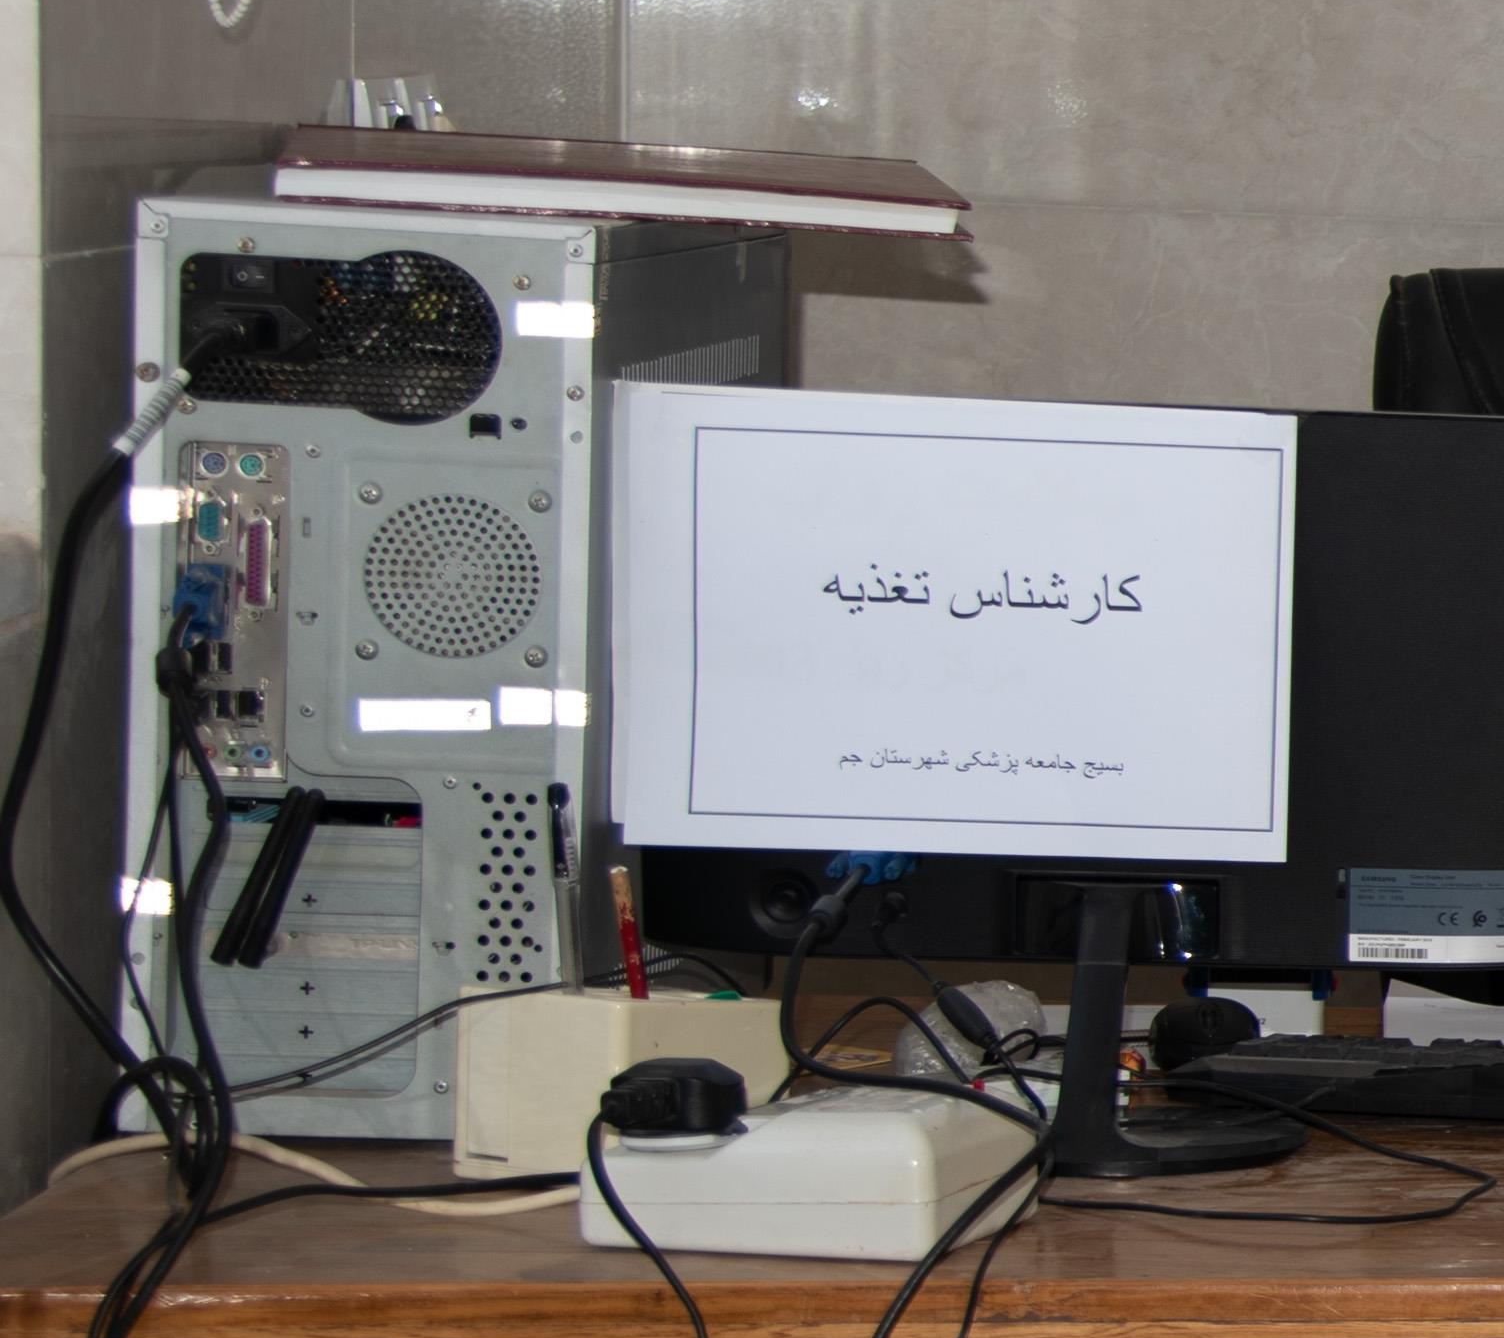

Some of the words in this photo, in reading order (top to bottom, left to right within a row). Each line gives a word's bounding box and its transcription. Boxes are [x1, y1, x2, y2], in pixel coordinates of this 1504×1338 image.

[822, 563, 930, 615] تغذیه
[949, 570, 1142, 625] کارشناس
[839, 754, 863, 769] جم
[870, 749, 949, 770] شهرستان
[955, 751, 1019, 775] پزشکی
[1025, 754, 1076, 773] جامعه
[1083, 762, 1124, 779] بسیج
